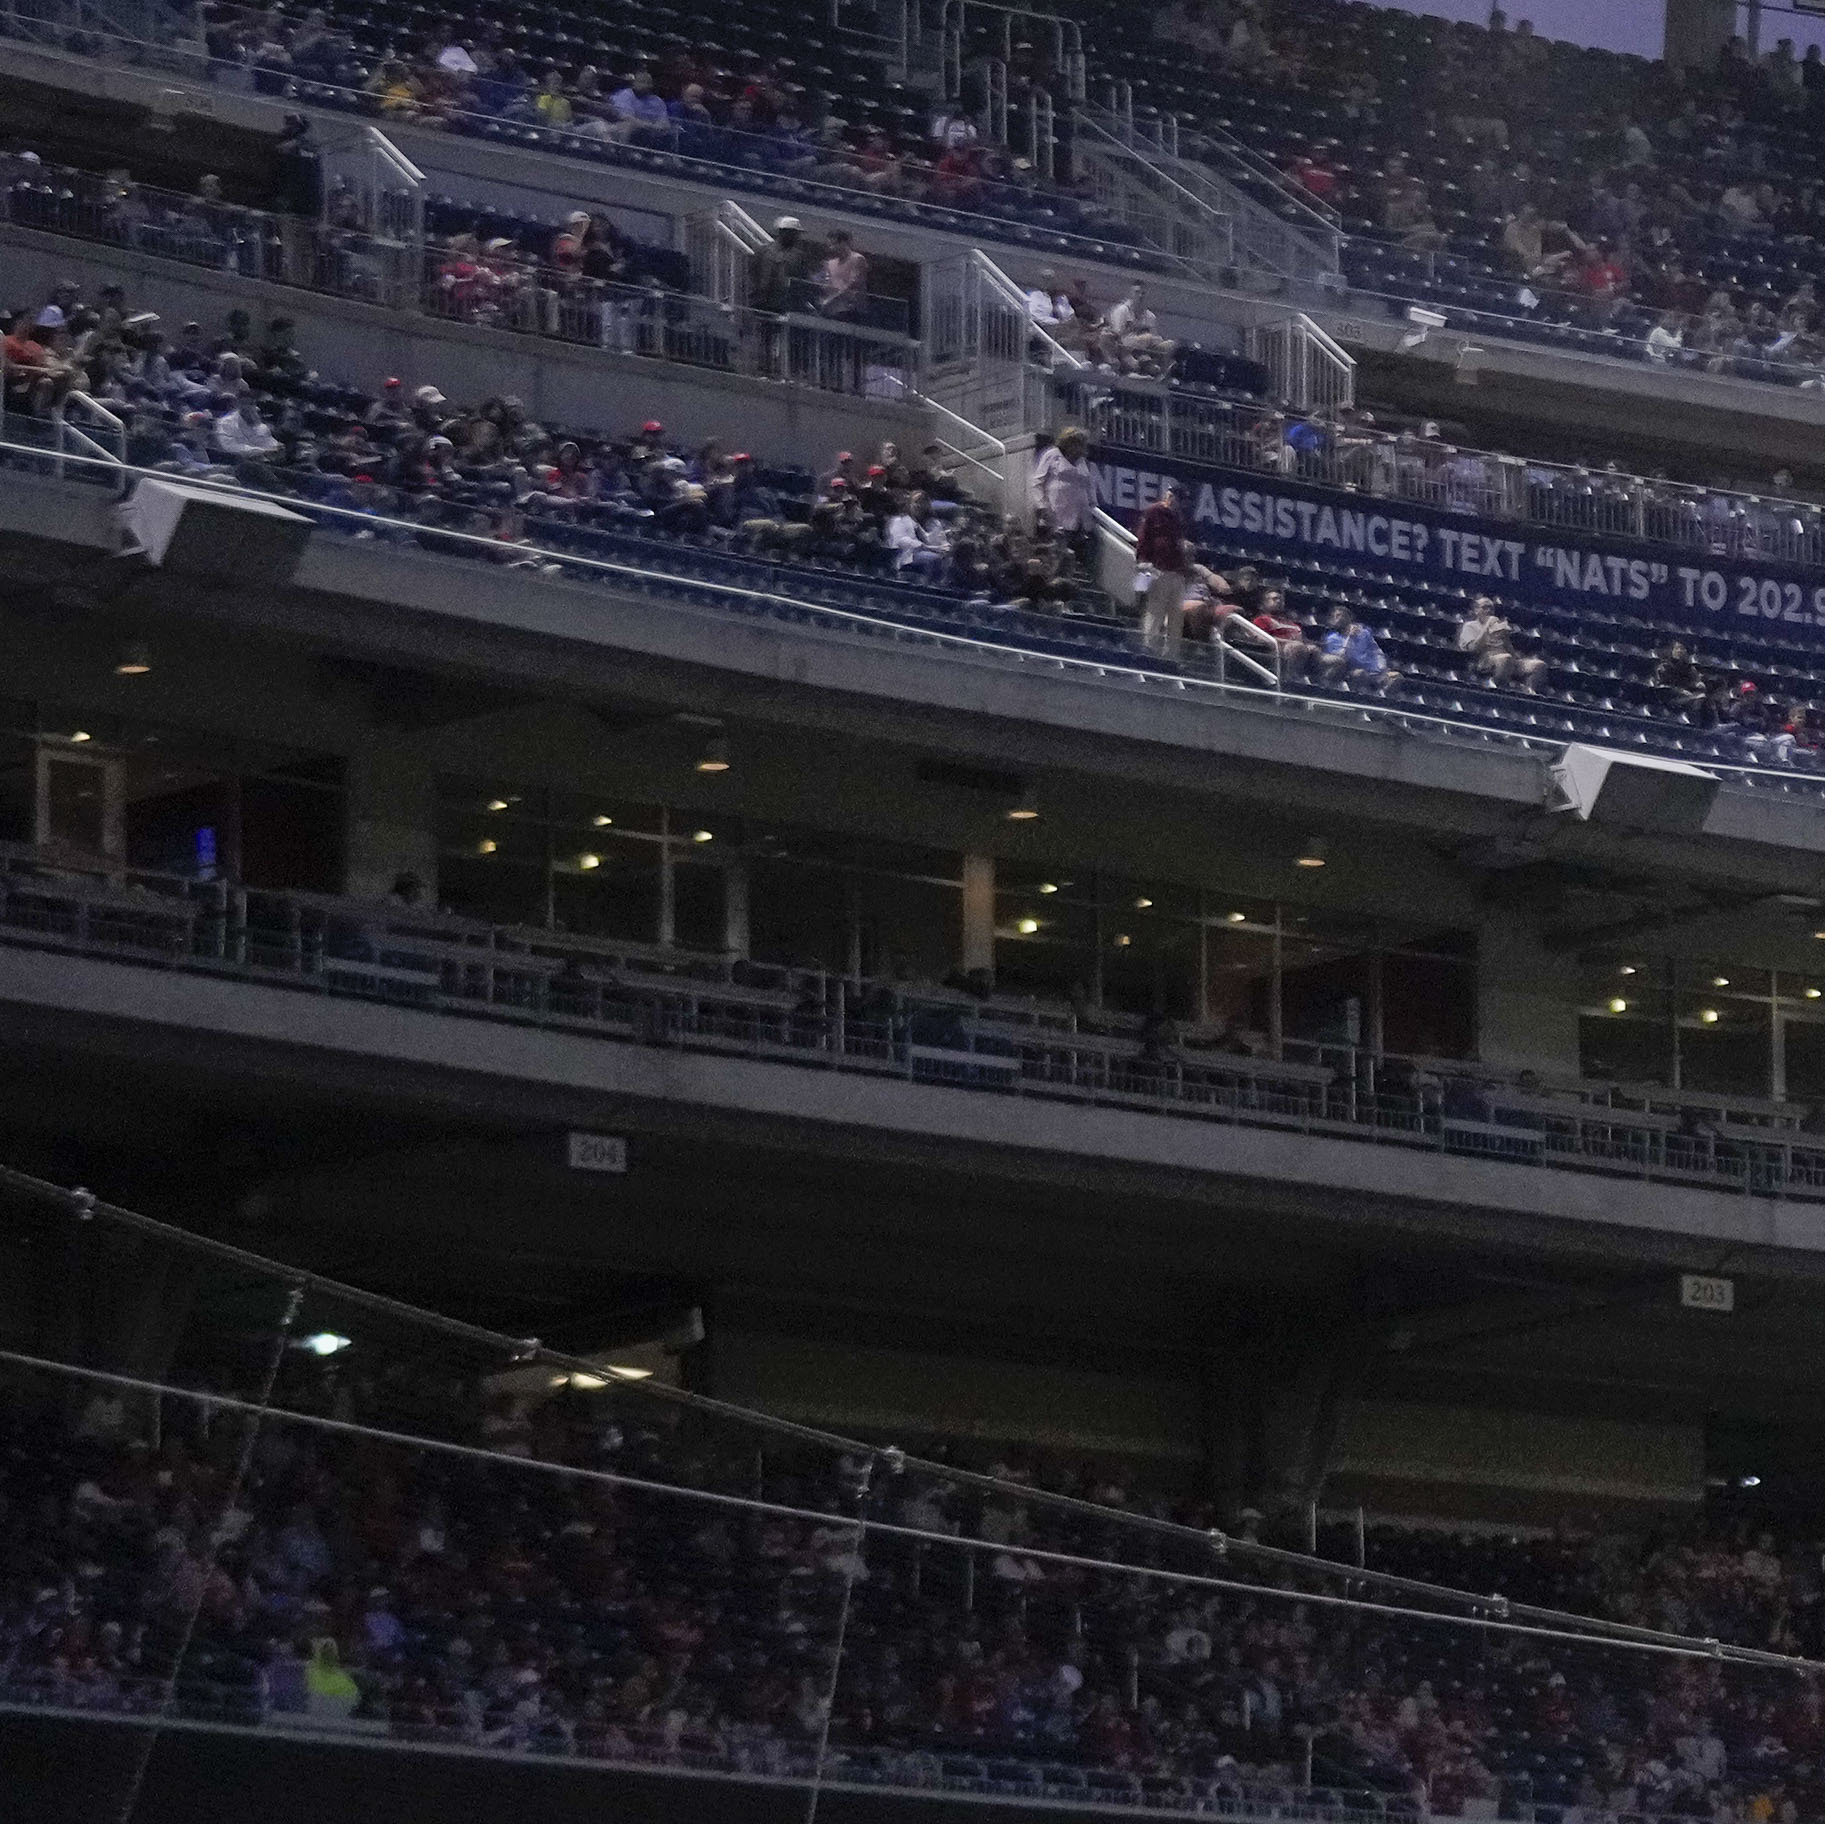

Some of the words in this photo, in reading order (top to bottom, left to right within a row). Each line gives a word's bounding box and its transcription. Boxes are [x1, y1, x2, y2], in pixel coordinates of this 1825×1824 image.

[1194, 484, 1429, 563] ASSISTANCE?
[1439, 528, 1525, 581] TEXT
[1679, 568, 1727, 610] TO
[1691, 1281, 1724, 1305] 203
